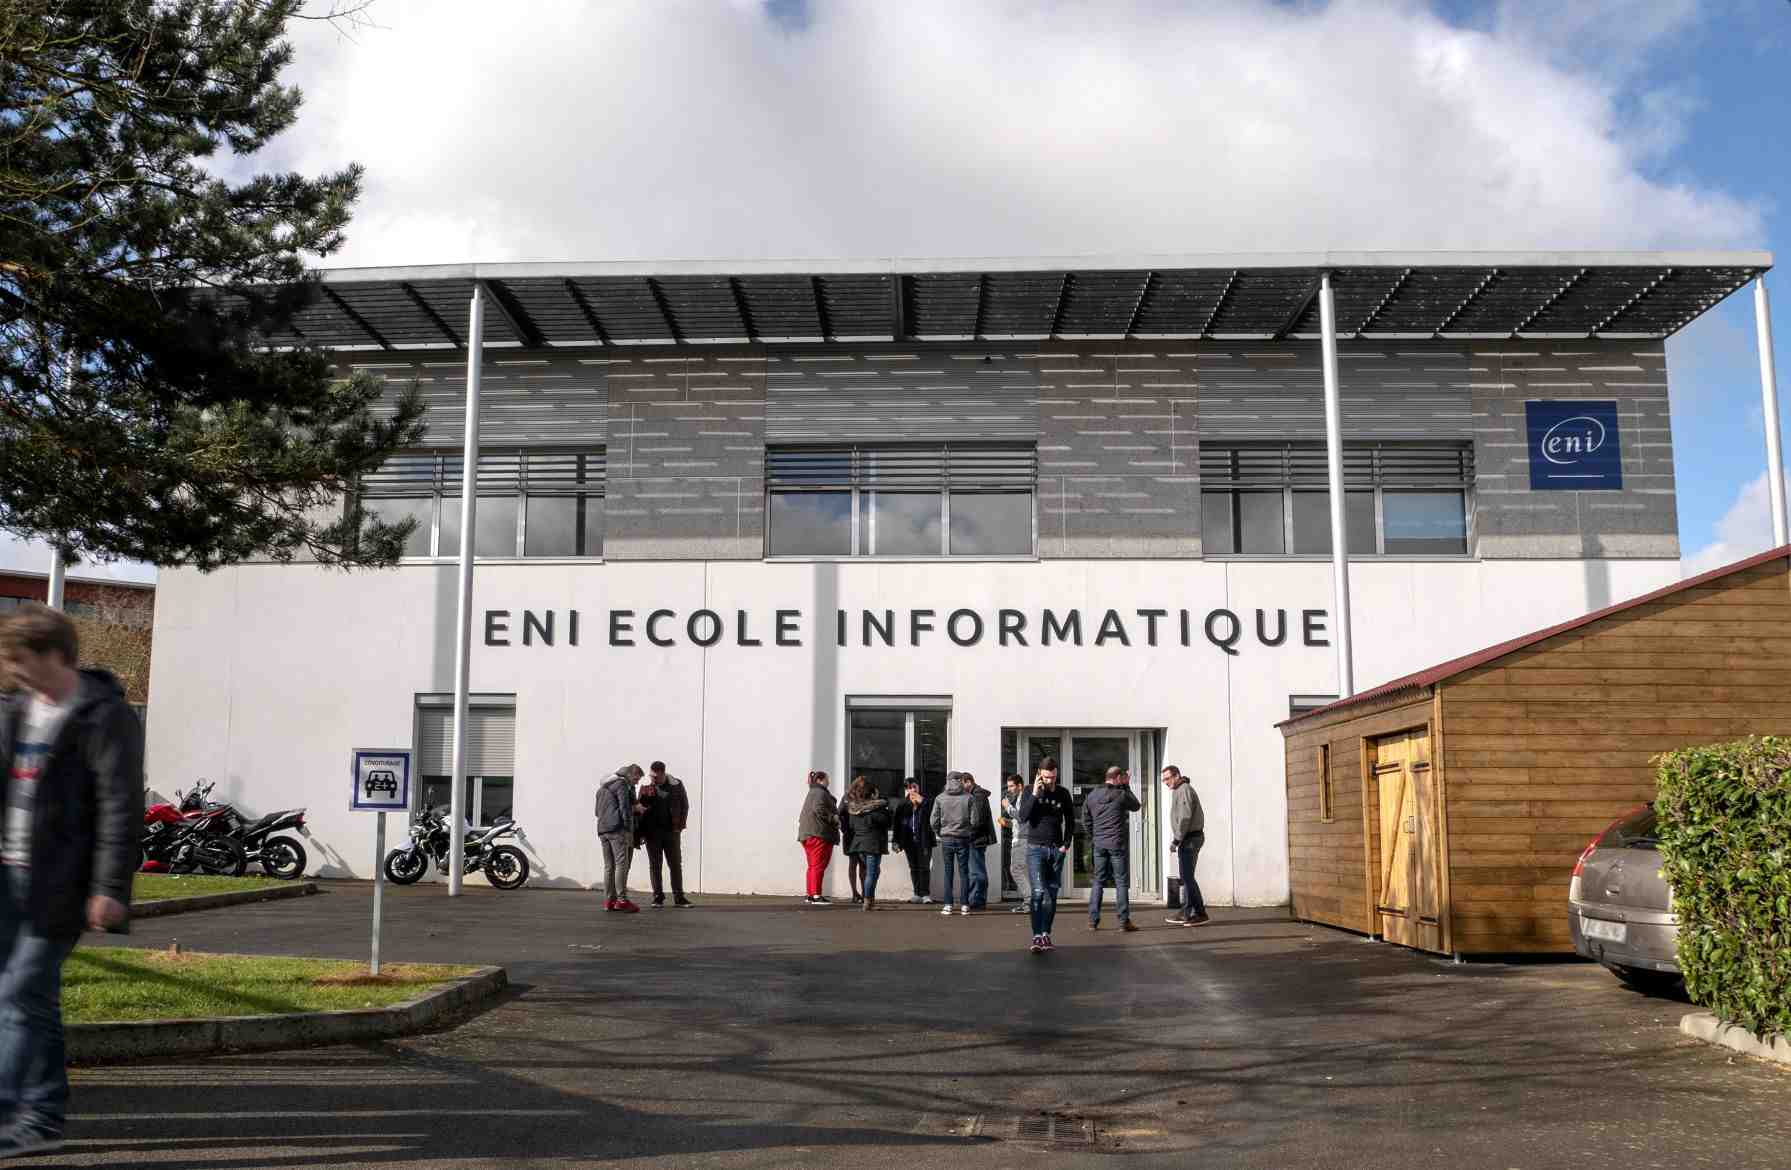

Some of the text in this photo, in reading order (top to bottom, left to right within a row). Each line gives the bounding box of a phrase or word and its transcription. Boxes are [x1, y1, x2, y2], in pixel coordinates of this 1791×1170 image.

[1547, 430, 1594, 453] eni
[484, 609, 1330, 655] ENI ECOLE INFORMATIQUE
